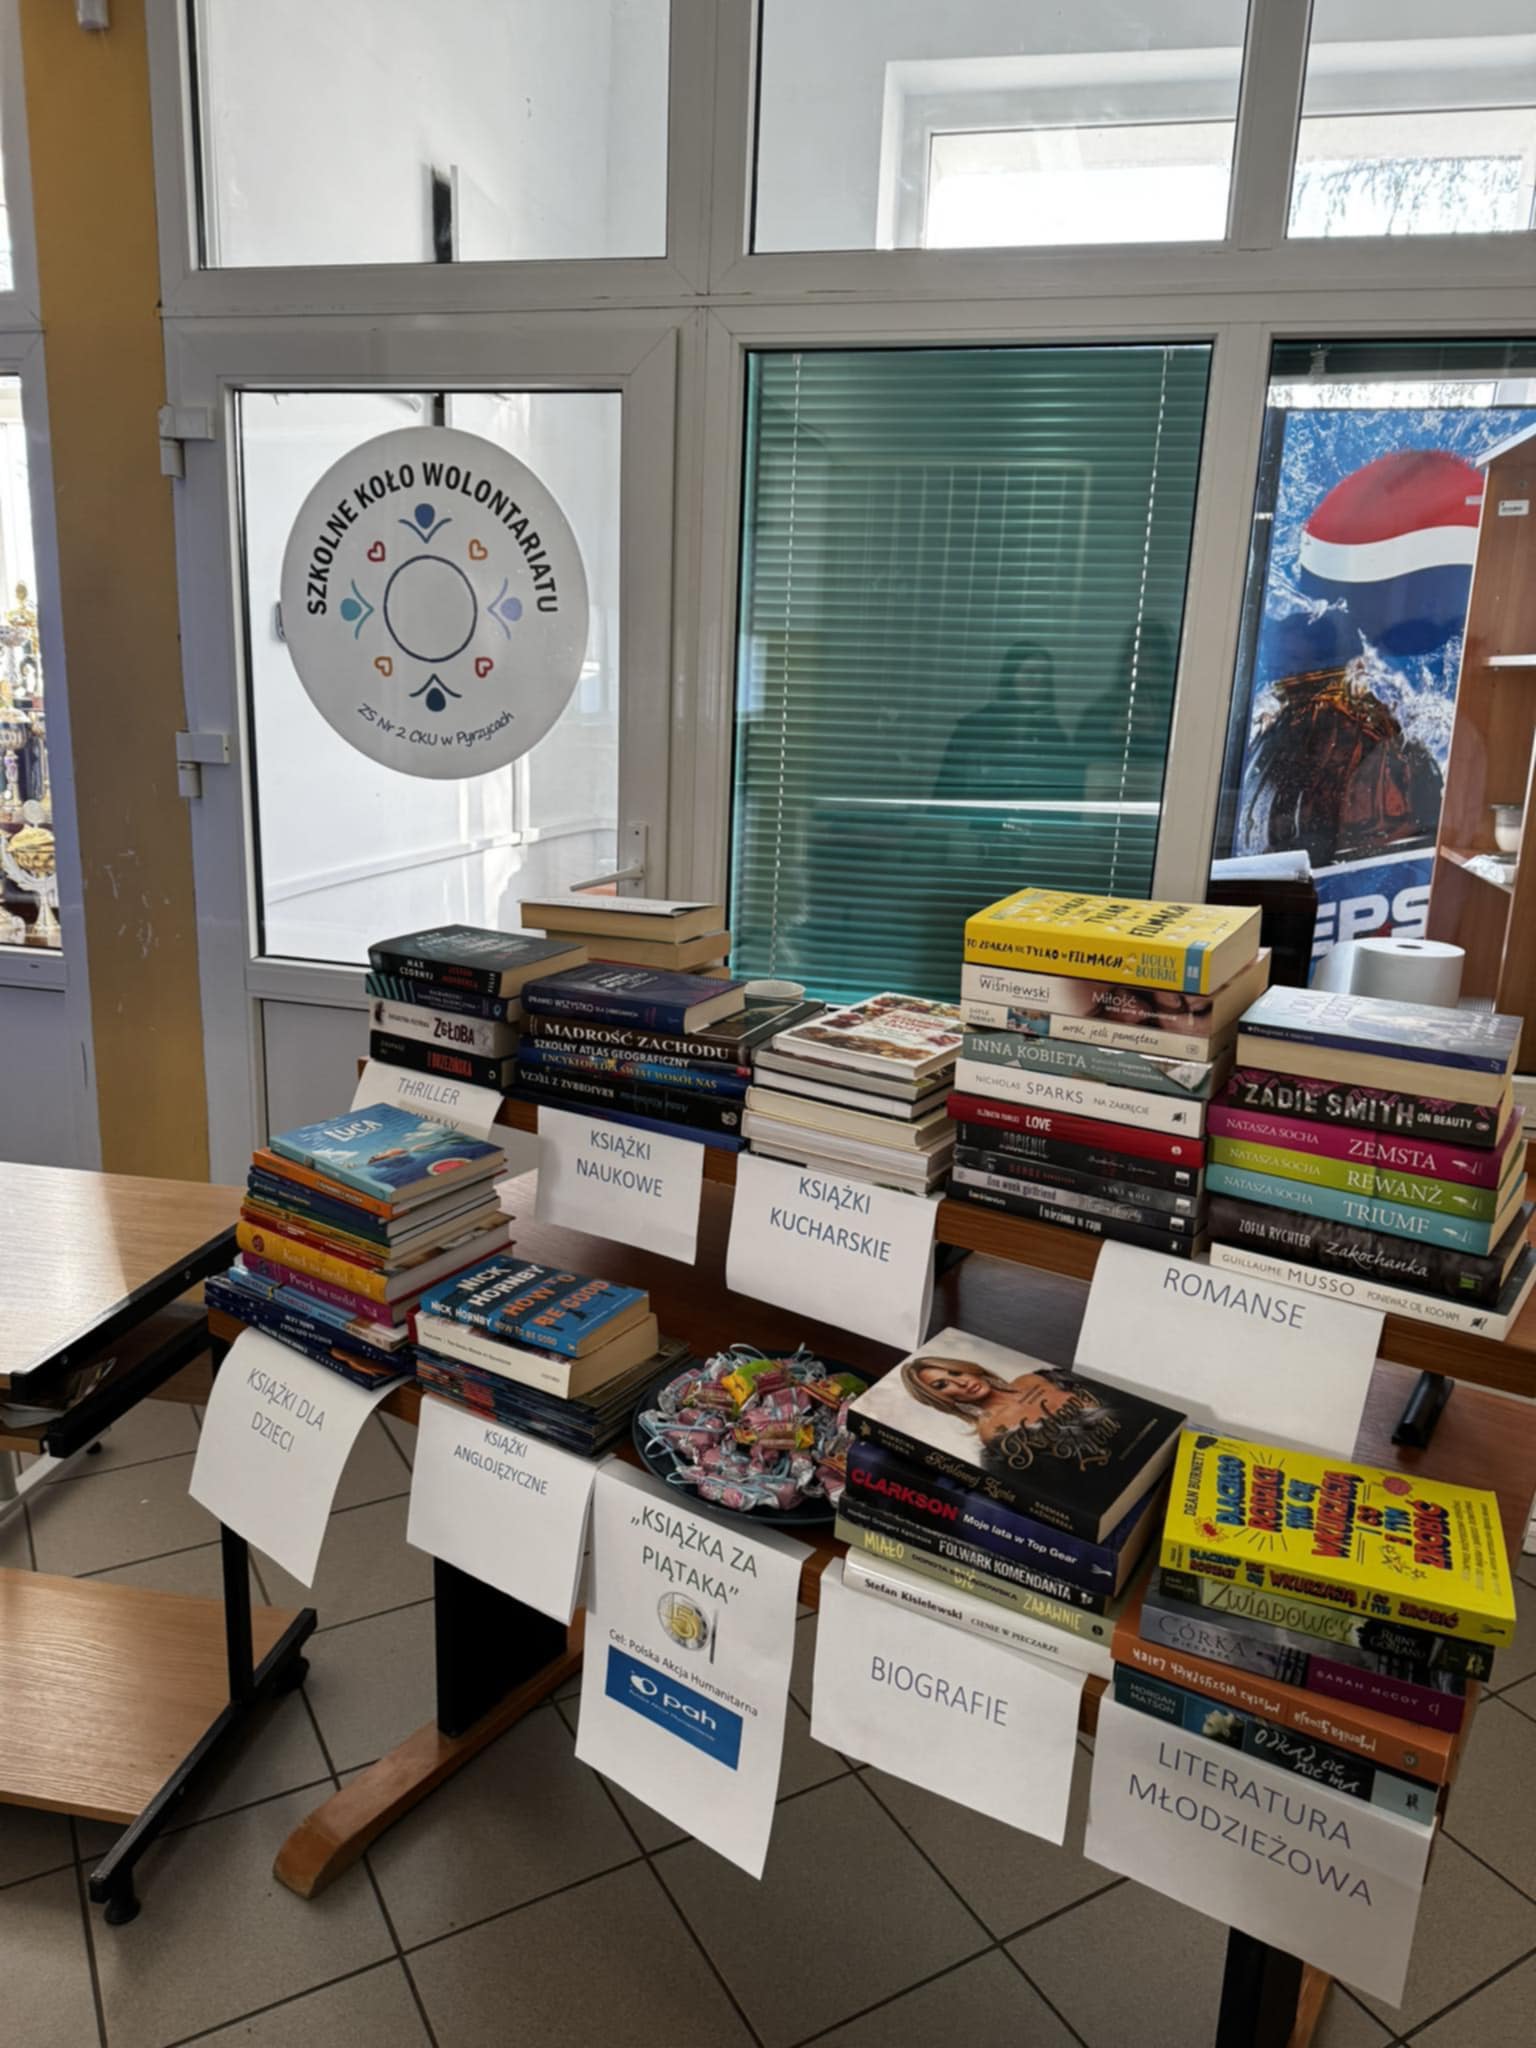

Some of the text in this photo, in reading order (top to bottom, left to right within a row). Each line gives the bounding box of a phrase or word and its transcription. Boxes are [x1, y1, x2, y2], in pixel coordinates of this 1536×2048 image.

[307, 462, 558, 616] SZKOLNE KOŁO WOLONTARIATU
[357, 703, 515, 748] ZS Nr 2 CKU w Pyrzycach
[407, 959, 424, 970] MAX
[979, 941, 1013, 953] ZDARZA
[1025, 945, 1058, 960] TYLKO
[1067, 950, 1123, 968] FILMACH
[1135, 966, 1178, 983] BOURNE
[1141, 953, 1176, 968] HOLLY
[555, 999, 594, 1013] WSZYSTKO
[979, 977, 1050, 998] Wiśniewski
[1092, 992, 1137, 1008] Miłość
[534, 1038, 690, 1068] SZKOLNY ATLAS GEOGRAFICZNY
[544, 1023, 729, 1060] MĄDROŚĆ ZACHODU
[972, 1038, 1013, 1056] INNA
[1017, 1045, 1087, 1069] KOBIETA
[398, 1078, 460, 1105] THRILLER
[520, 1069, 614, 1098] KRAJOBRAZ Z TĘCZĄ
[542, 1053, 617, 1073] ENCYKLOPEDIA
[695, 1078, 717, 1090] NAS
[975, 1075, 1149, 1115] NICHOLAS SPARKS NA ZAKRĘCIE
[1245, 1082, 1472, 1129] ZADIE SMITH ON BEAUTY
[324, 1119, 383, 1143] LUCA
[1025, 1114, 1052, 1132] LOVE
[1226, 1118, 1437, 1171] NATASZA SOCHA ZEMSTA
[590, 1130, 651, 1161] KSIĄŻKI
[576, 1158, 664, 1197] NAUKOWE
[799, 1177, 871, 1214] KSIĄŻKI
[1229, 1148, 1443, 1206] NATASZA SOCHA REWANŻ
[1224, 1175, 1430, 1234] NATASZA SOCHA TRIUMF
[770, 1207, 892, 1262] KUCHARSKIE
[1238, 1219, 1266, 1239] ZOFIA
[1325, 1240, 1430, 1279] Zakochanka
[456, 1265, 512, 1292] NICK
[468, 1264, 545, 1307] HORNBY
[502, 1273, 577, 1317] HOW TO
[1222, 1253, 1282, 1277] GUILLAUME
[1287, 1267, 1355, 1297] MUSSO
[532, 1280, 609, 1326] BE GOOD
[1163, 1268, 1307, 1329] ROMANSE
[431, 1300, 557, 1346] NICK HORNBY HOW TO BE GOOD
[246, 1367, 325, 1432] KSIĄŻKI DLA
[250, 1411, 295, 1453] DZIECI
[484, 1428, 528, 1459] KSIĄŻKI
[453, 1443, 548, 1496] ANGLOJĘZYCZNE
[1184, 1451, 1205, 1516] DEAN BURNETT
[1216, 1455, 1246, 1526] DLACZEGO
[851, 1468, 960, 1522] CLARKSON
[963, 1514, 990, 1533] Moje
[992, 1525, 1012, 1541] lata
[1015, 1535, 1025, 1544] w
[1027, 1538, 1048, 1556] Top
[1049, 1546, 1078, 1566] Gear
[1248, 1465, 1285, 1532] RODZICE
[1287, 1503, 1313, 1529] TAK
[1312, 1470, 1364, 1558] WKURZAJĄ
[1357, 1505, 1383, 1526] CO
[1384, 1506, 1411, 1533] TYM
[630, 1506, 757, 1577] „KSIĄŻKA ZA
[1405, 1499, 1453, 1570] ZROBIĆ
[642, 1545, 739, 1604] PIĄTAKA”
[864, 1531, 1083, 1632] MIAŁO ZABAWNIE
[939, 1540, 1071, 1600] FOLWARK KOMENDANTA
[1270, 1569, 1357, 1608] WKURZAJĄ
[672, 1607, 697, 1638] 5
[864, 1578, 1059, 1654] Stefan Kisielewski CIENIE W PIECZARZE
[1207, 1582, 1355, 1641] ZWIADOWCY
[1398, 1601, 1459, 1629] ZROBIĆ
[1159, 1614, 1246, 1658] CÓRKA
[1381, 1629, 1417, 1648] RUINY
[609, 1628, 758, 1717] Cel: Polska Akcja Humanitarna
[871, 1656, 1009, 1727] BIOGRAFIE
[1132, 1647, 1281, 1714] Matka Wszystkich Lalek
[1316, 1670, 1364, 1690] SARAH
[663, 1692, 717, 1731] pah
[1130, 1683, 1176, 1706] MORGAN
[1130, 1692, 1175, 1715] MATSON
[1157, 1741, 1352, 1849] LITERATURA
[1127, 1773, 1373, 1906] MŁODZIEŻOWA
